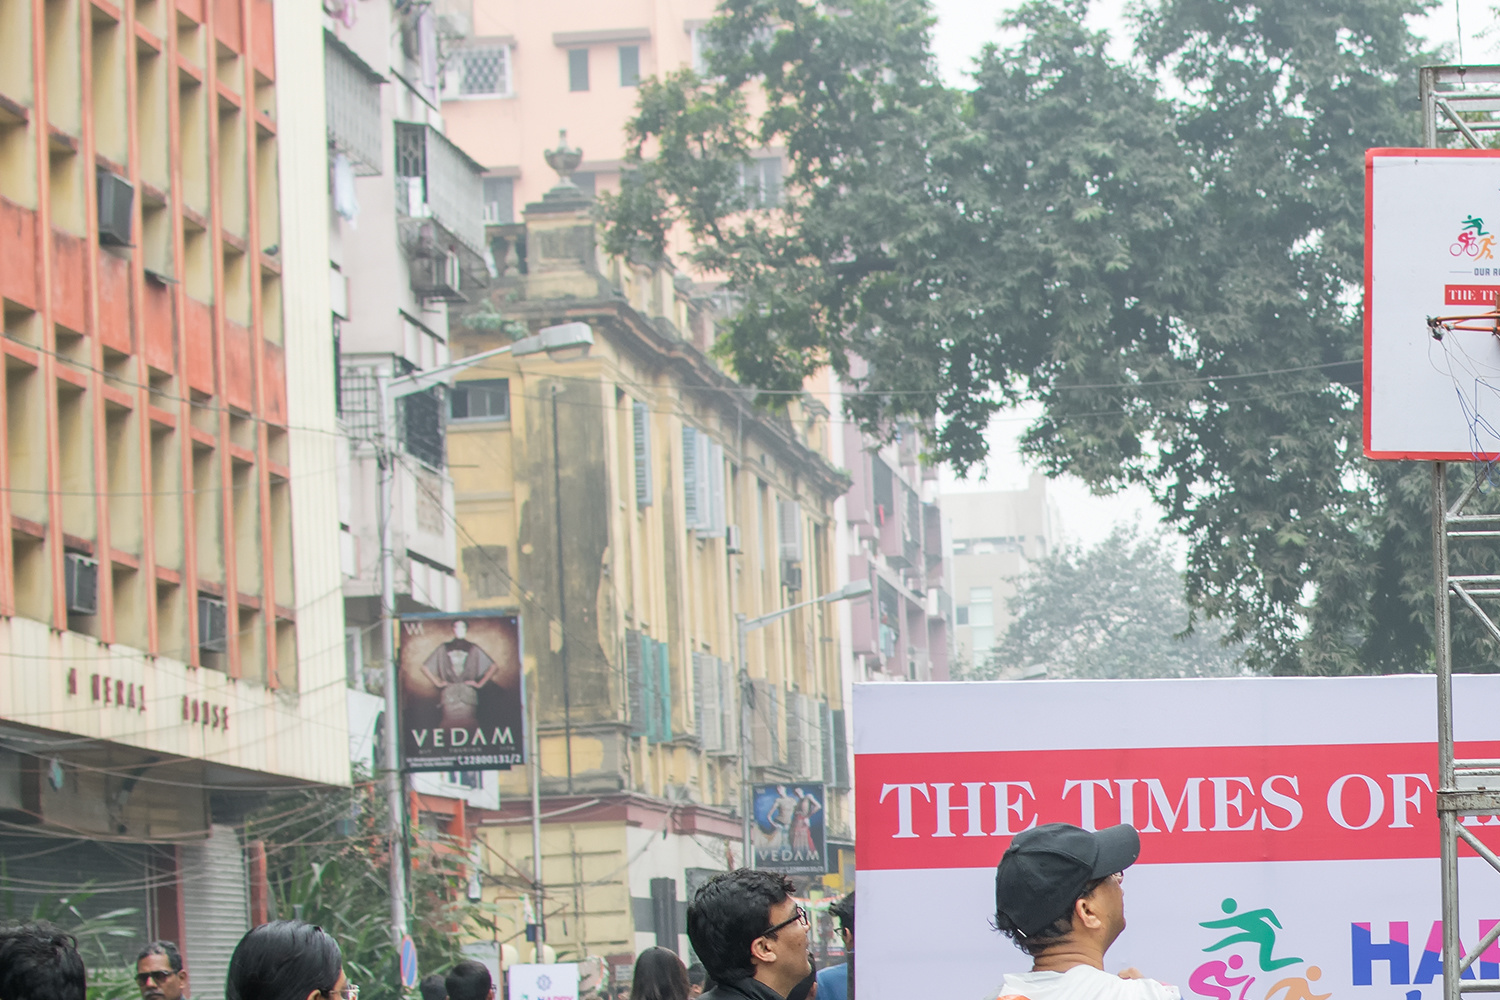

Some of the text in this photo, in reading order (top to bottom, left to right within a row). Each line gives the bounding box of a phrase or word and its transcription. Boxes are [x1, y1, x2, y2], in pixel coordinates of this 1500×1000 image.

[1474, 268, 1490, 276] OUR
[1449, 290, 1476, 301] THE
[411, 726, 514, 748] VEDAM
[879, 781, 1039, 838] THE
[1061, 774, 1304, 834] TIMES
[1326, 772, 1434, 831] OF
[758, 849, 820, 862] VEDAM
